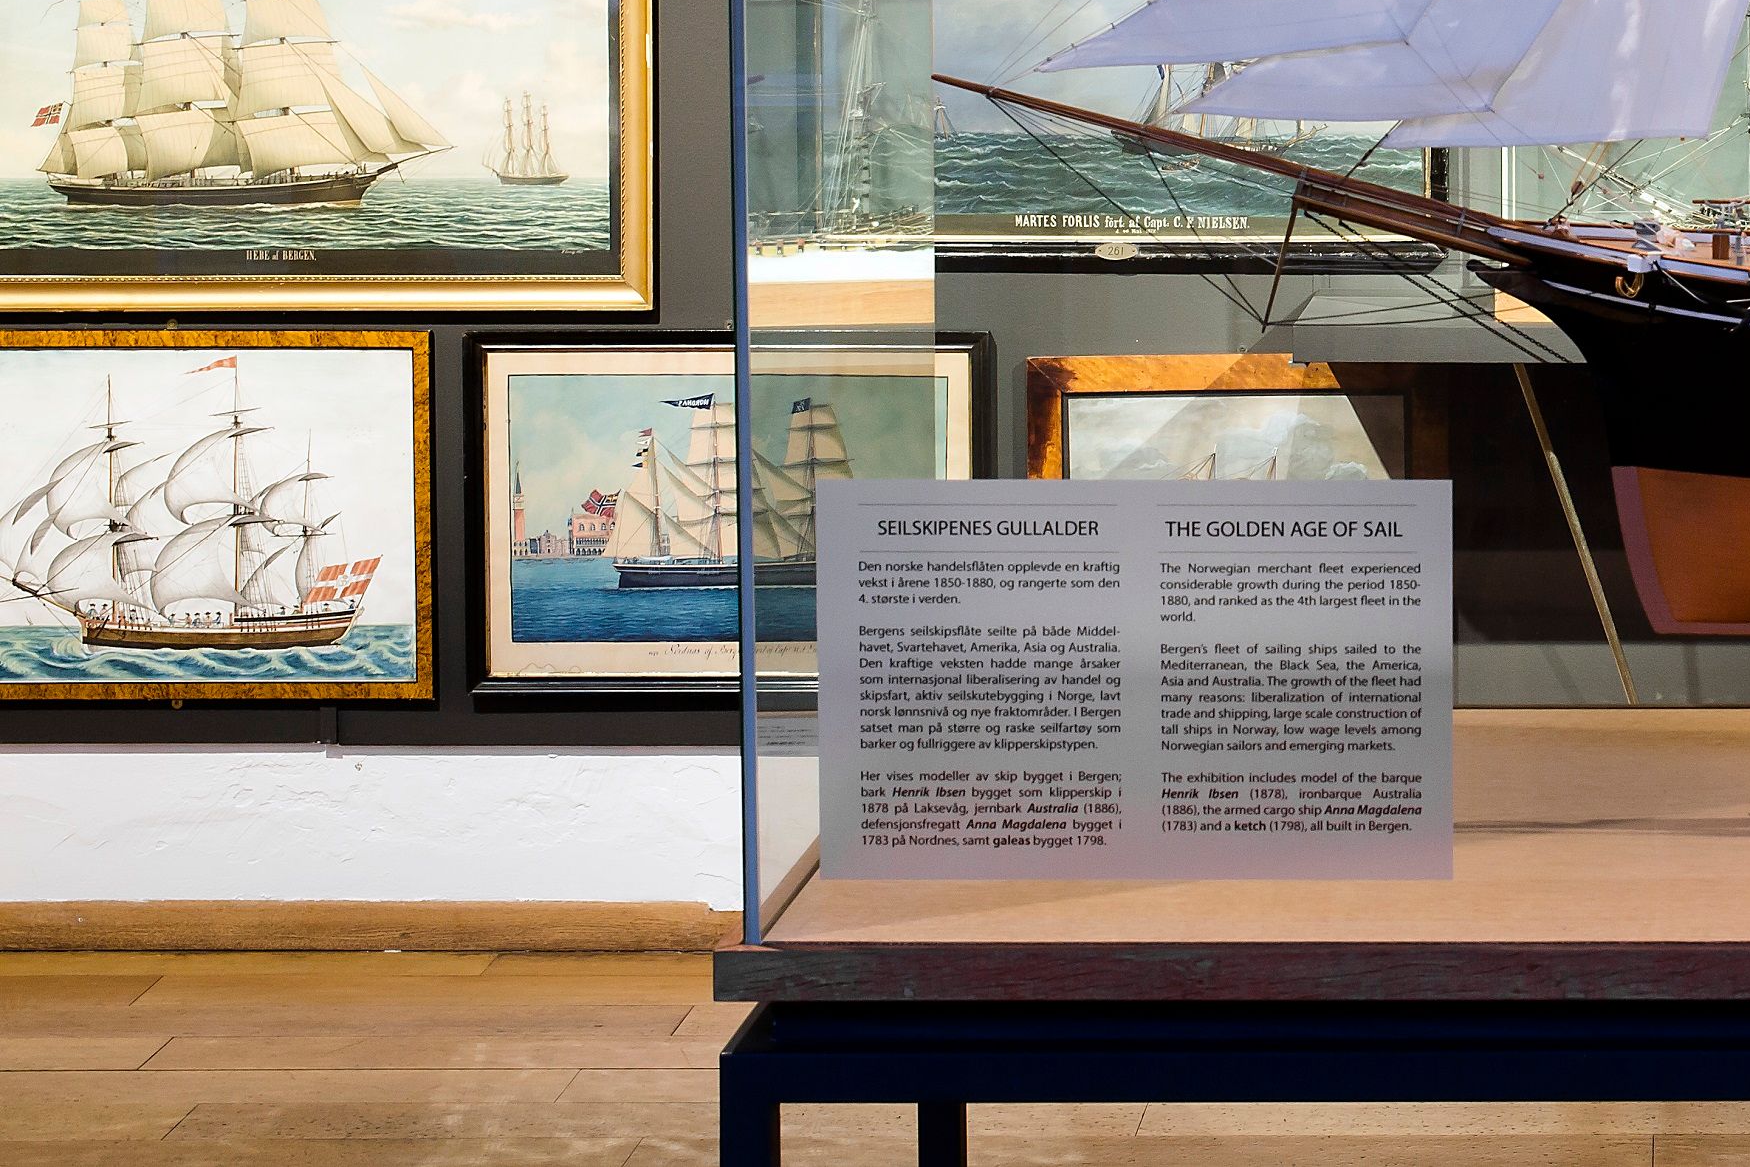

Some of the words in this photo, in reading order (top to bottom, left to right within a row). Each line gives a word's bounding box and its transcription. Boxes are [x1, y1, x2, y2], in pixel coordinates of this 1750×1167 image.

[1015, 214, 1057, 228] MARTES
[1062, 214, 1101, 228] FORLIS
[1173, 216, 1184, 228] C.
[1197, 216, 1250, 230] NIELSEN.
[246, 250, 270, 261] HEBE
[1107, 246, 1125, 256] 261
[878, 520, 992, 536] SEILSKIPENES
[996, 520, 1098, 536] GULLALDER
[1164, 521, 1201, 537] THE
[1206, 521, 1284, 537] GOLDEN
[1290, 521, 1328, 537] AGE
[1333, 521, 1358, 537] OF
[1364, 521, 1403, 538] SAIL
[858, 560, 882, 572] Den
[885, 560, 924, 572] norske
[927, 560, 1004, 572] handelsflåten
[1007, 560, 1062, 574] opplevde
[1064, 564, 1079, 572] en
[1083, 561, 1120, 574] kraftig
[1160, 562, 1181, 574] The
[1188, 563, 1250, 576] Norwegian
[1257, 563, 1312, 574] merchant
[1319, 562, 1344, 574] fleet
[1350, 563, 1421, 576] experienced
[858, 576, 888, 588] vekst
[898, 576, 930, 588] årene
[934, 577, 996, 589] 1850-1880,
[999, 580, 1014, 591] og
[1018, 578, 1067, 591] rangerte
[1070, 580, 1094, 588] som
[1098, 578, 1120, 588] den
[1160, 579, 1233, 590] considerable
[1237, 579, 1278, 592] growth
[1282, 579, 1320, 592] during
[1324, 579, 1344, 590] the
[1347, 579, 1385, 593] period
[1390, 579, 1421, 590] 1850-
[858, 593, 869, 604] 4.
[871, 594, 910, 604] største
[918, 593, 961, 604] verden.
[1162, 595, 1191, 607] 1880,
[1194, 595, 1216, 606] and
[1218, 595, 1258, 606] ranked
[1260, 598, 1273, 606] as
[1276, 595, 1294, 606] the
[1297, 595, 1316, 606] 4th
[1319, 595, 1358, 609] largest
[1360, 594, 1386, 606] fleet
[1388, 595, 1400, 606] in
[1402, 595, 1422, 606] the
[1160, 611, 1196, 622] world.
[860, 771, 880, 781] Her
[886, 770, 914, 781] vises
[919, 770, 970, 782] modeller
[976, 773, 990, 782] av
[994, 770, 1018, 784] skip
[1023, 770, 1063, 784] bygget
[1078, 770, 1122, 784] Bergen;
[1161, 772, 1183, 783] The
[1186, 772, 1244, 783] exhibition
[1249, 772, 1296, 783] includes
[1301, 772, 1337, 783] model
[1342, 772, 1354, 783] of
[1358, 772, 1377, 783] the
[1381, 772, 1422, 786] barque
[860, 786, 886, 798] bark
[892, 786, 930, 798] Henrik
[936, 786, 966, 798] Ibsen
[972, 786, 1012, 800] bygget
[1018, 789, 1042, 798] som
[1049, 786, 1112, 800] klipperskip
[1161, 788, 1199, 799] Henrik
[1208, 788, 1239, 799] Ibsen
[1250, 788, 1288, 801] (1878),
[1299, 788, 1362, 802] ironbarque
[1372, 788, 1422, 799] Australia
[862, 803, 889, 814] 1878
[894, 802, 909, 816] på
[914, 802, 969, 816] Laksevåg,
[974, 802, 1022, 816] jernbark
[1026, 802, 1079, 814] Australia
[1084, 803, 1122, 814] (1886),
[1162, 804, 1200, 816] (1886),
[1202, 804, 1222, 815] the
[1224, 804, 1261, 815] armed
[1263, 807, 1296, 818] cargo
[1298, 804, 1322, 818] ship
[1324, 804, 1355, 815] Anna
[1356, 804, 1422, 818] Magdalena
[861, 818, 960, 832] defensjonsfregatt
[966, 819, 996, 830] Anna
[1002, 818, 1067, 832] Magdalena
[1072, 819, 1112, 832] bygget
[1162, 820, 1197, 833] (1783)
[1200, 820, 1223, 831] and
[1234, 820, 1266, 831] ketch
[1269, 820, 1308, 832] (1798),
[1310, 820, 1323, 832] all
[1326, 820, 1352, 832] built
[1355, 821, 1366, 831] in
[1368, 820, 1412, 834] Bergen.
[862, 835, 889, 846] 1783
[892, 834, 906, 848] på
[909, 834, 960, 846] Nordnes,
[962, 836, 990, 846] samt
[992, 834, 1031, 848] galeas
[1033, 835, 1073, 848] bygget
[1077, 835, 1106, 846] 1798.
